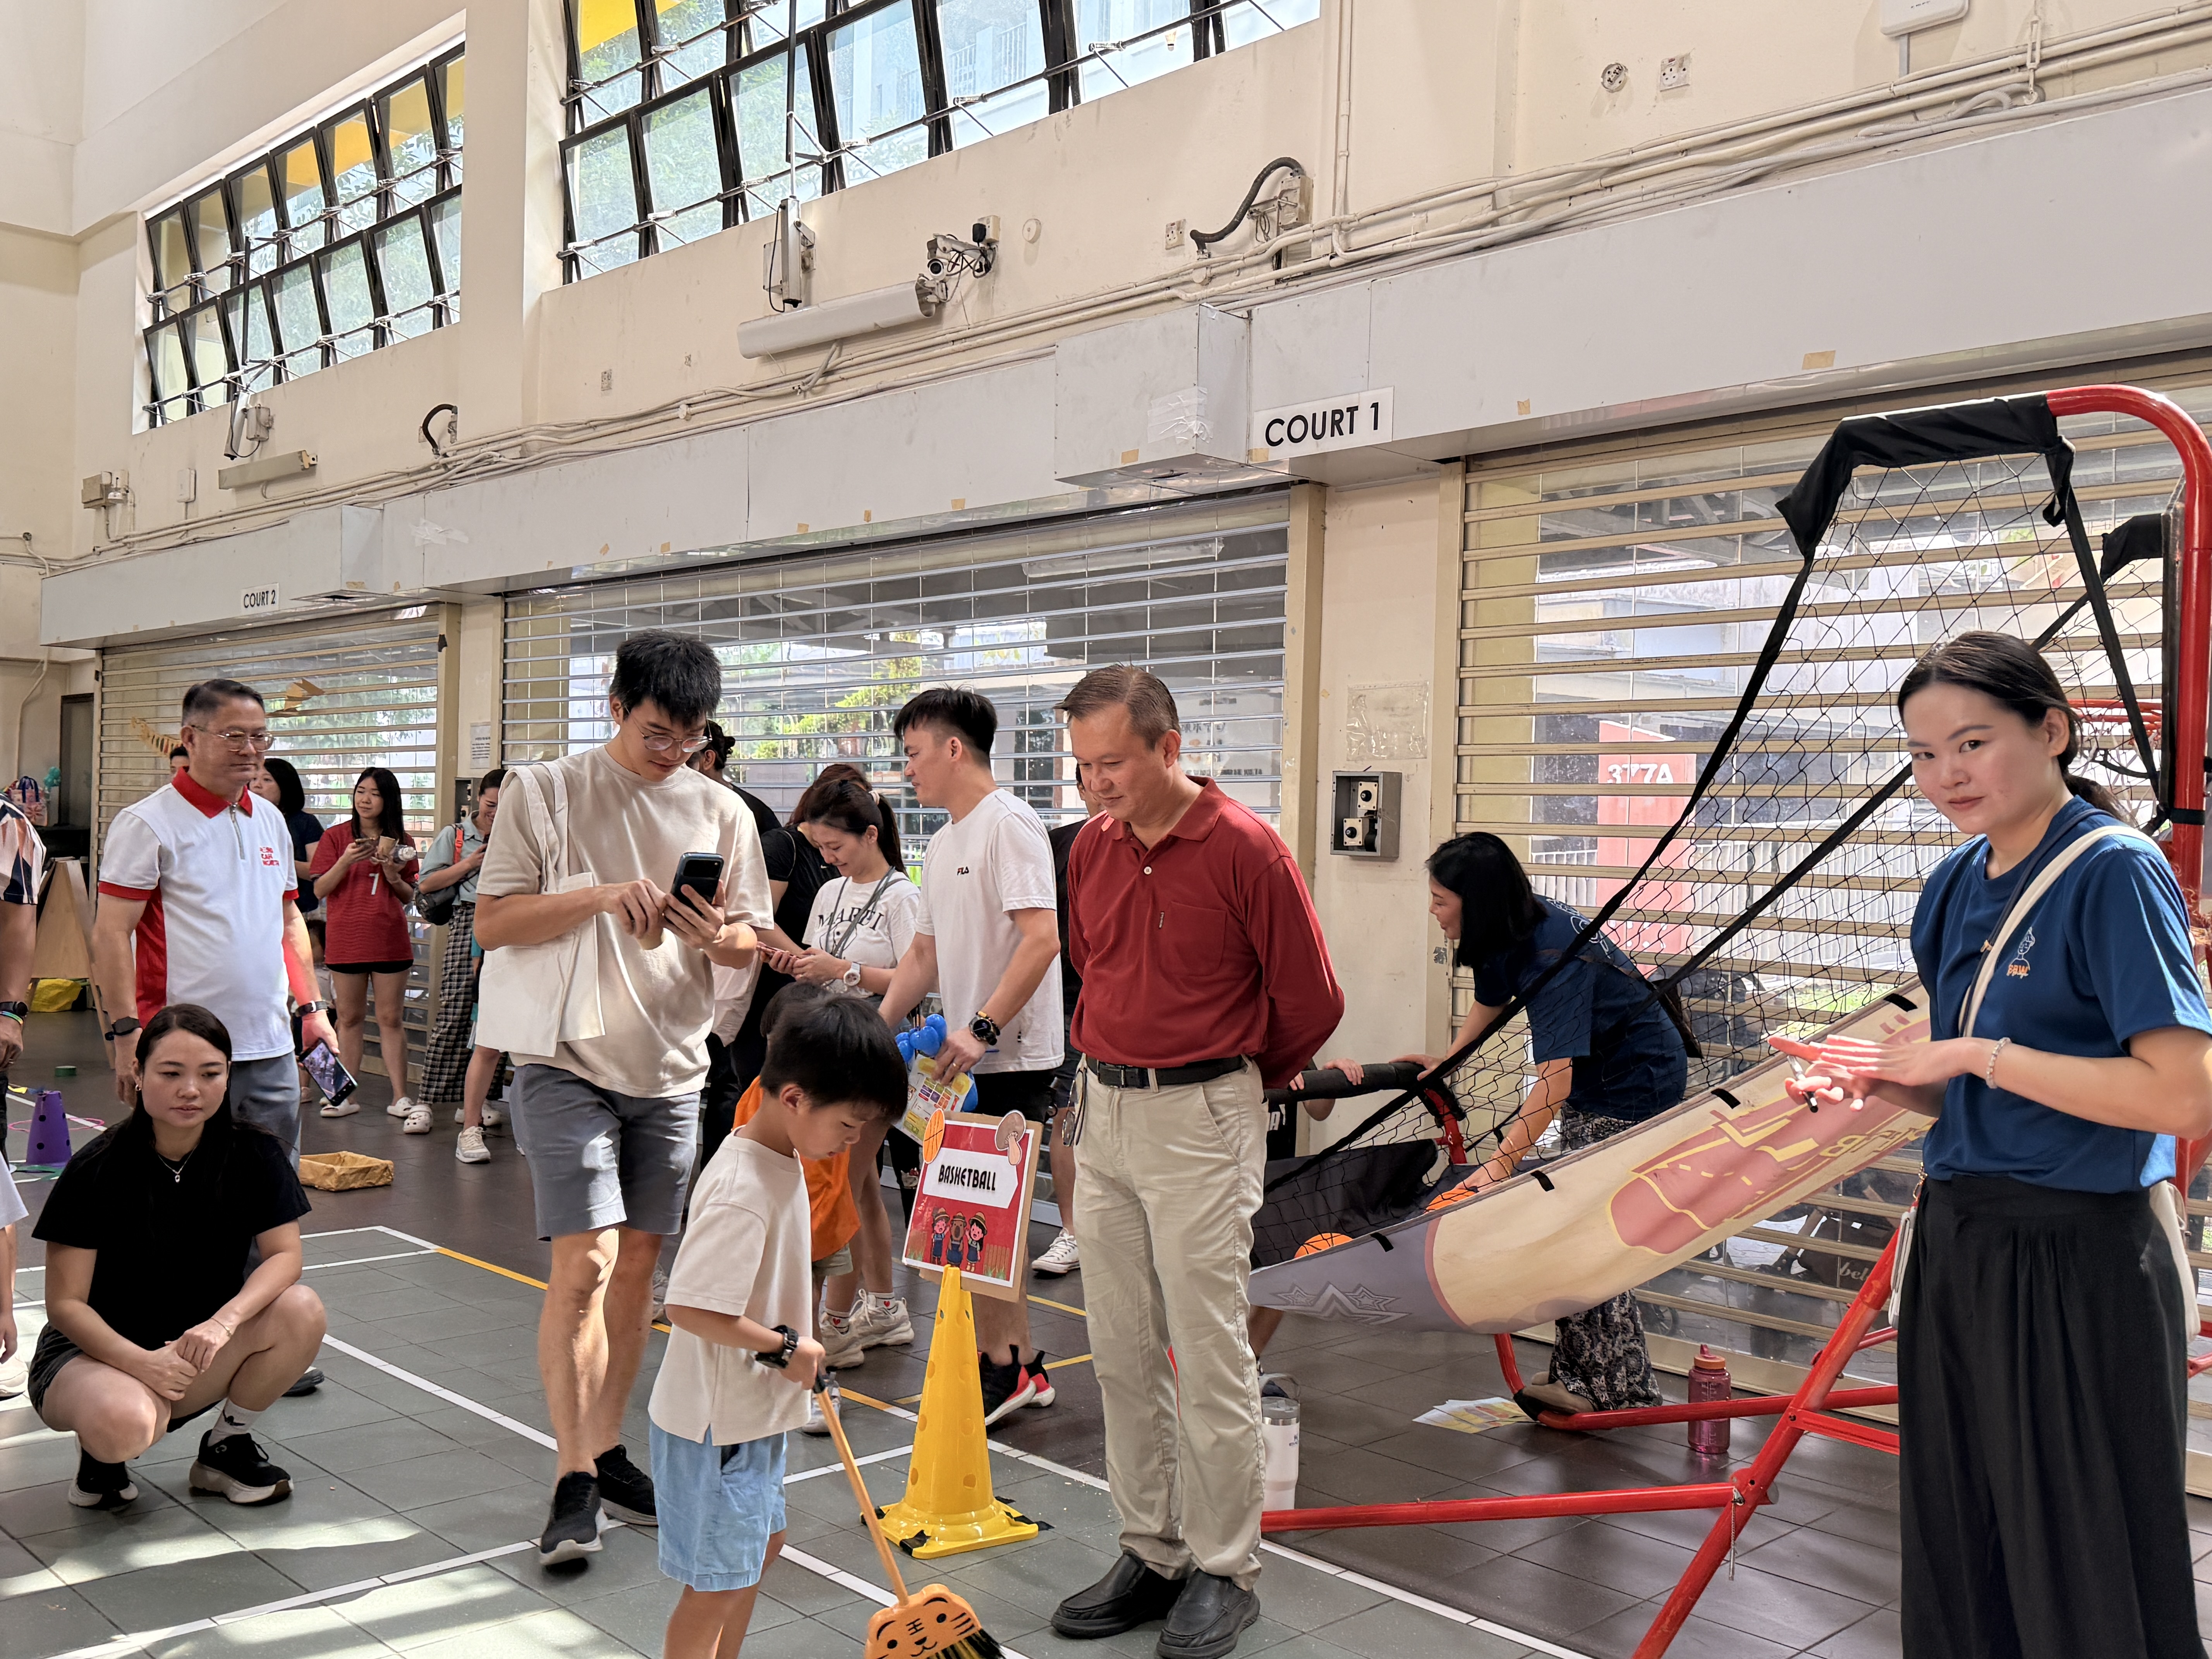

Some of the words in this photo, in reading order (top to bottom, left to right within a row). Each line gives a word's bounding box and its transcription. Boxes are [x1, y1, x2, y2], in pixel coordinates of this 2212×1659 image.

[1265, 405, 1358, 447] COURT
[1370, 402, 1379, 430] 1
[244, 591, 269, 608] COURT
[271, 589, 275, 604] 2
[1607, 763, 1674, 784] 377A
[957, 866, 969, 876] FILA
[369, 872, 379, 895] 7
[938, 1164, 996, 1191] BASKETBALL
[1839, 1262, 1869, 1281] bel
